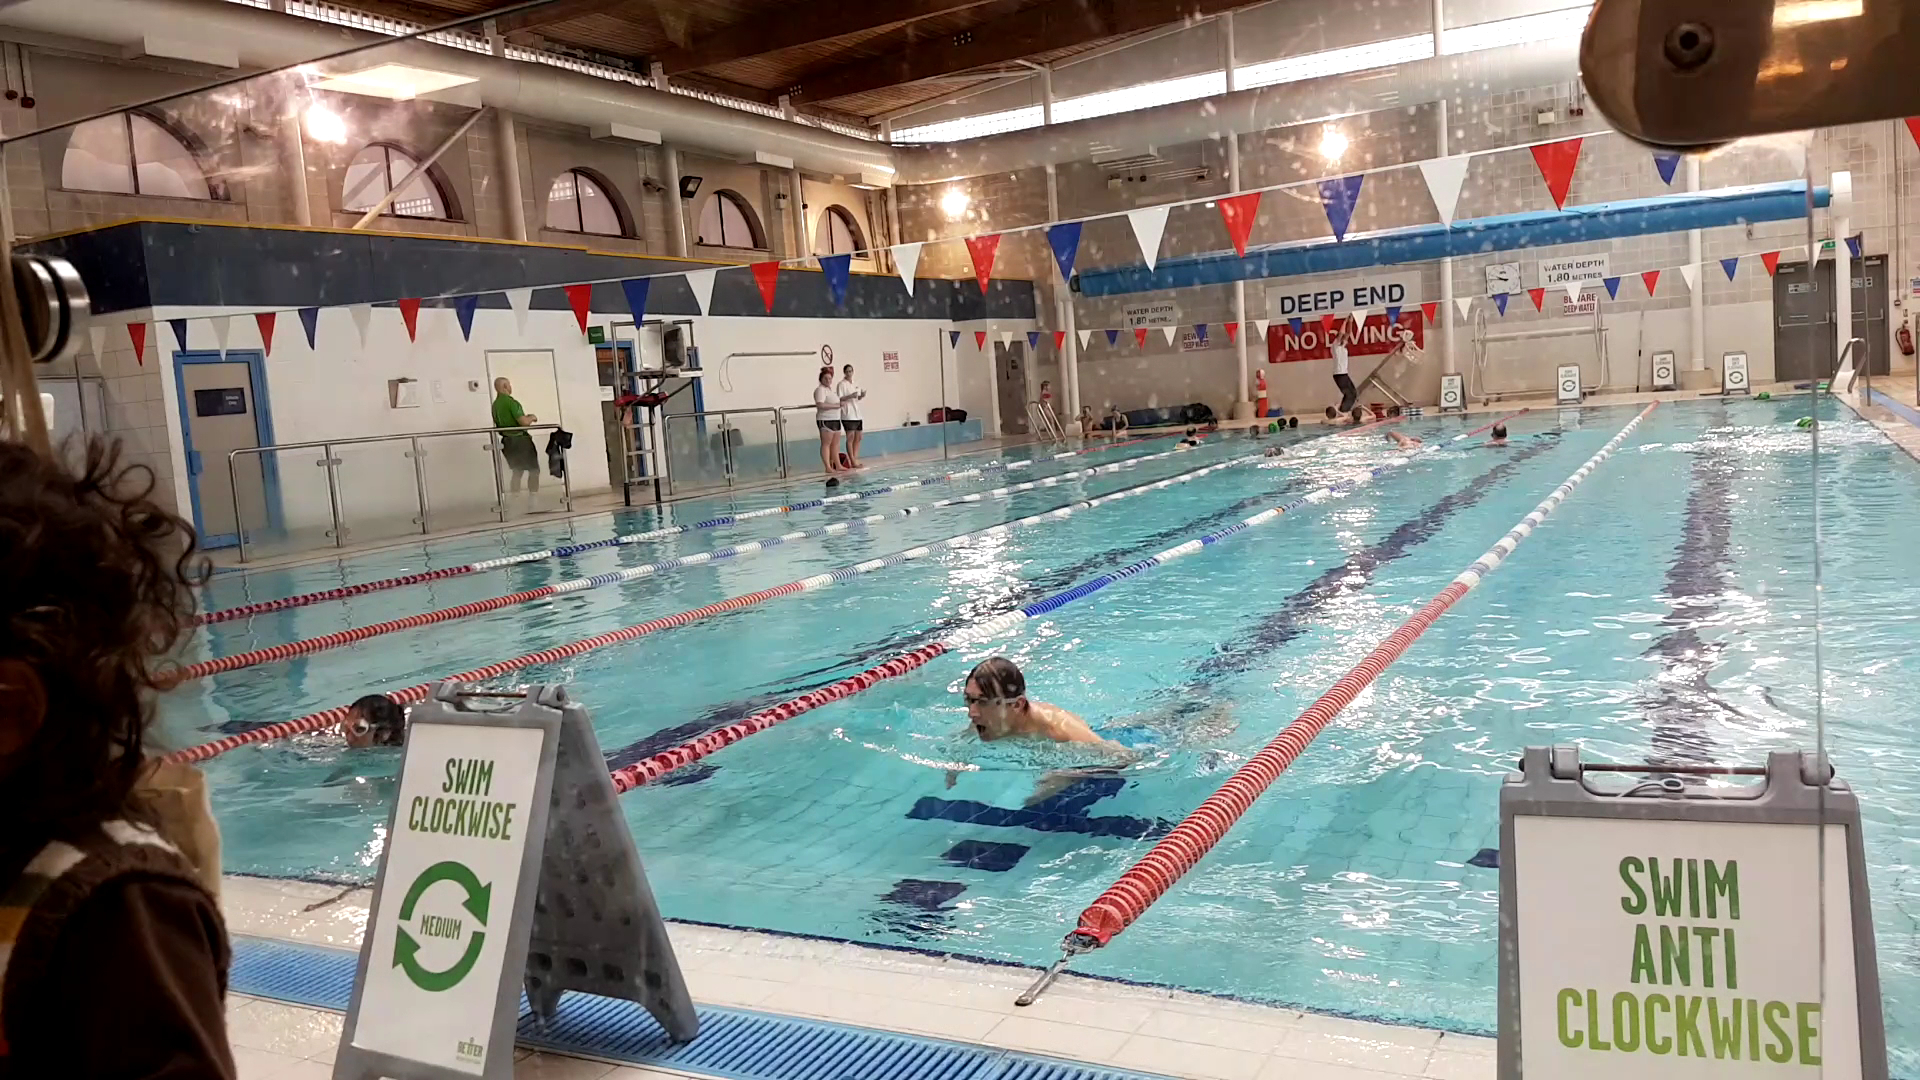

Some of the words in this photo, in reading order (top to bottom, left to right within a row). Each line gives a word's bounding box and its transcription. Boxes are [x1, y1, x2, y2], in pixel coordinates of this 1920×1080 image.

[1544, 262, 1573, 272] WATER
[1576, 259, 1604, 269] DEPTH
[1547, 272, 1570, 283] 1.80
[1572, 271, 1603, 281] METRES
[1126, 307, 1150, 316] WATER
[1150, 305, 1173, 314] DEPTH
[1280, 290, 1345, 315] DEEP
[1353, 283, 1405, 307] END
[1284, 331, 1318, 351] NO
[1325, 322, 1405, 348] DVING
[442, 758, 495, 797] SWIM
[408, 796, 517, 841] CLOCKWISE
[1619, 856, 1741, 920] SWIM
[420, 914, 463, 940] MEDIUM
[1630, 924, 1738, 989] ANTI
[1557, 987, 1822, 1066] CLOCKWISE
